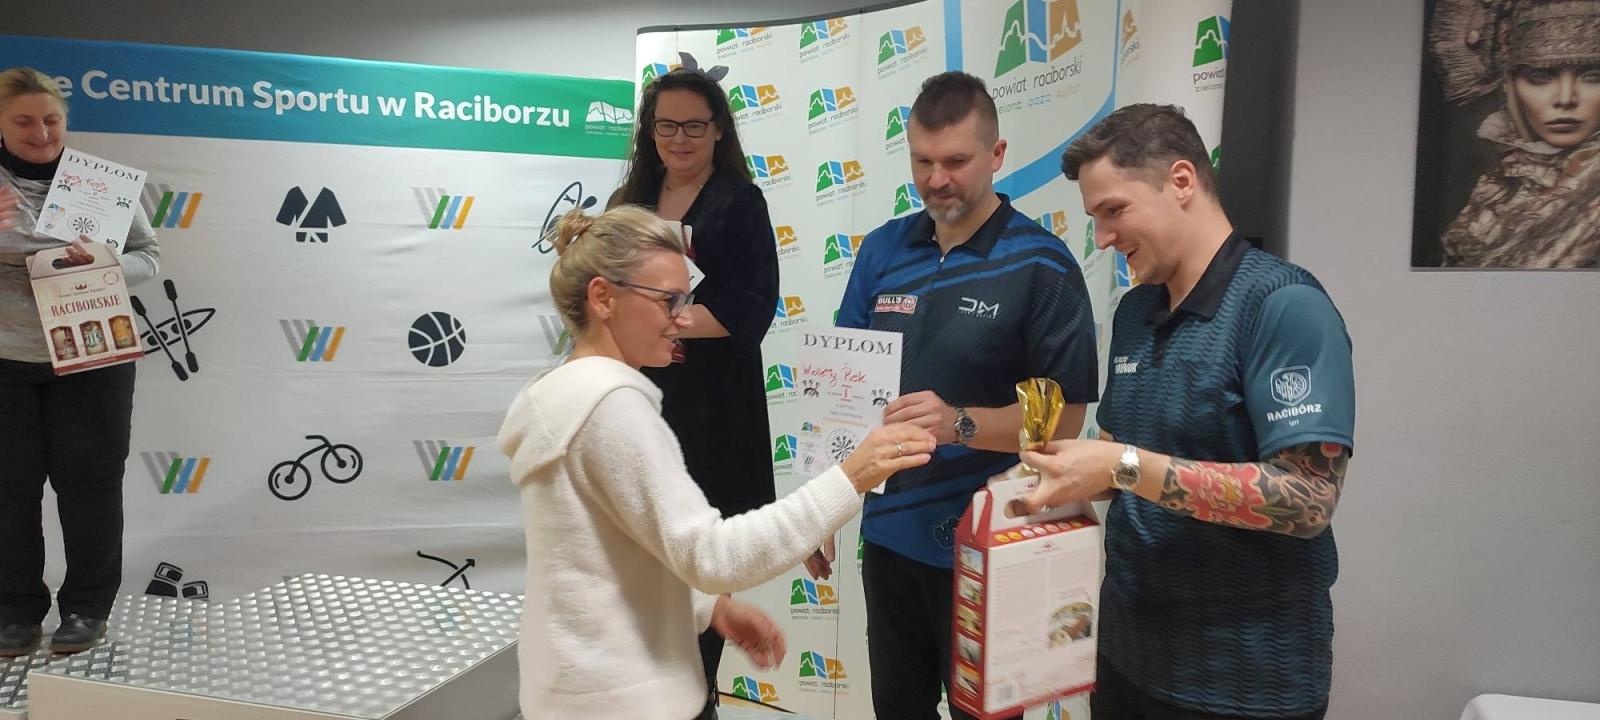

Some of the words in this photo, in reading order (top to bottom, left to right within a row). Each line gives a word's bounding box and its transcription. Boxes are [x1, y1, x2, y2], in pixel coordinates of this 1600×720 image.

[992, 77, 1027, 100] powiat
[1033, 56, 1083, 88] raciborski
[81, 69, 244, 108] Centrum
[252, 80, 369, 115] Sportu
[377, 95, 407, 117] w
[414, 91, 570, 128] Raciborzu
[68, 153, 141, 182] DYPLOM
[51, 295, 122, 318] RACIBORSKIE
[804, 333, 893, 355] DYPLOM
[1266, 403, 1322, 422] RACIBÓRZ
